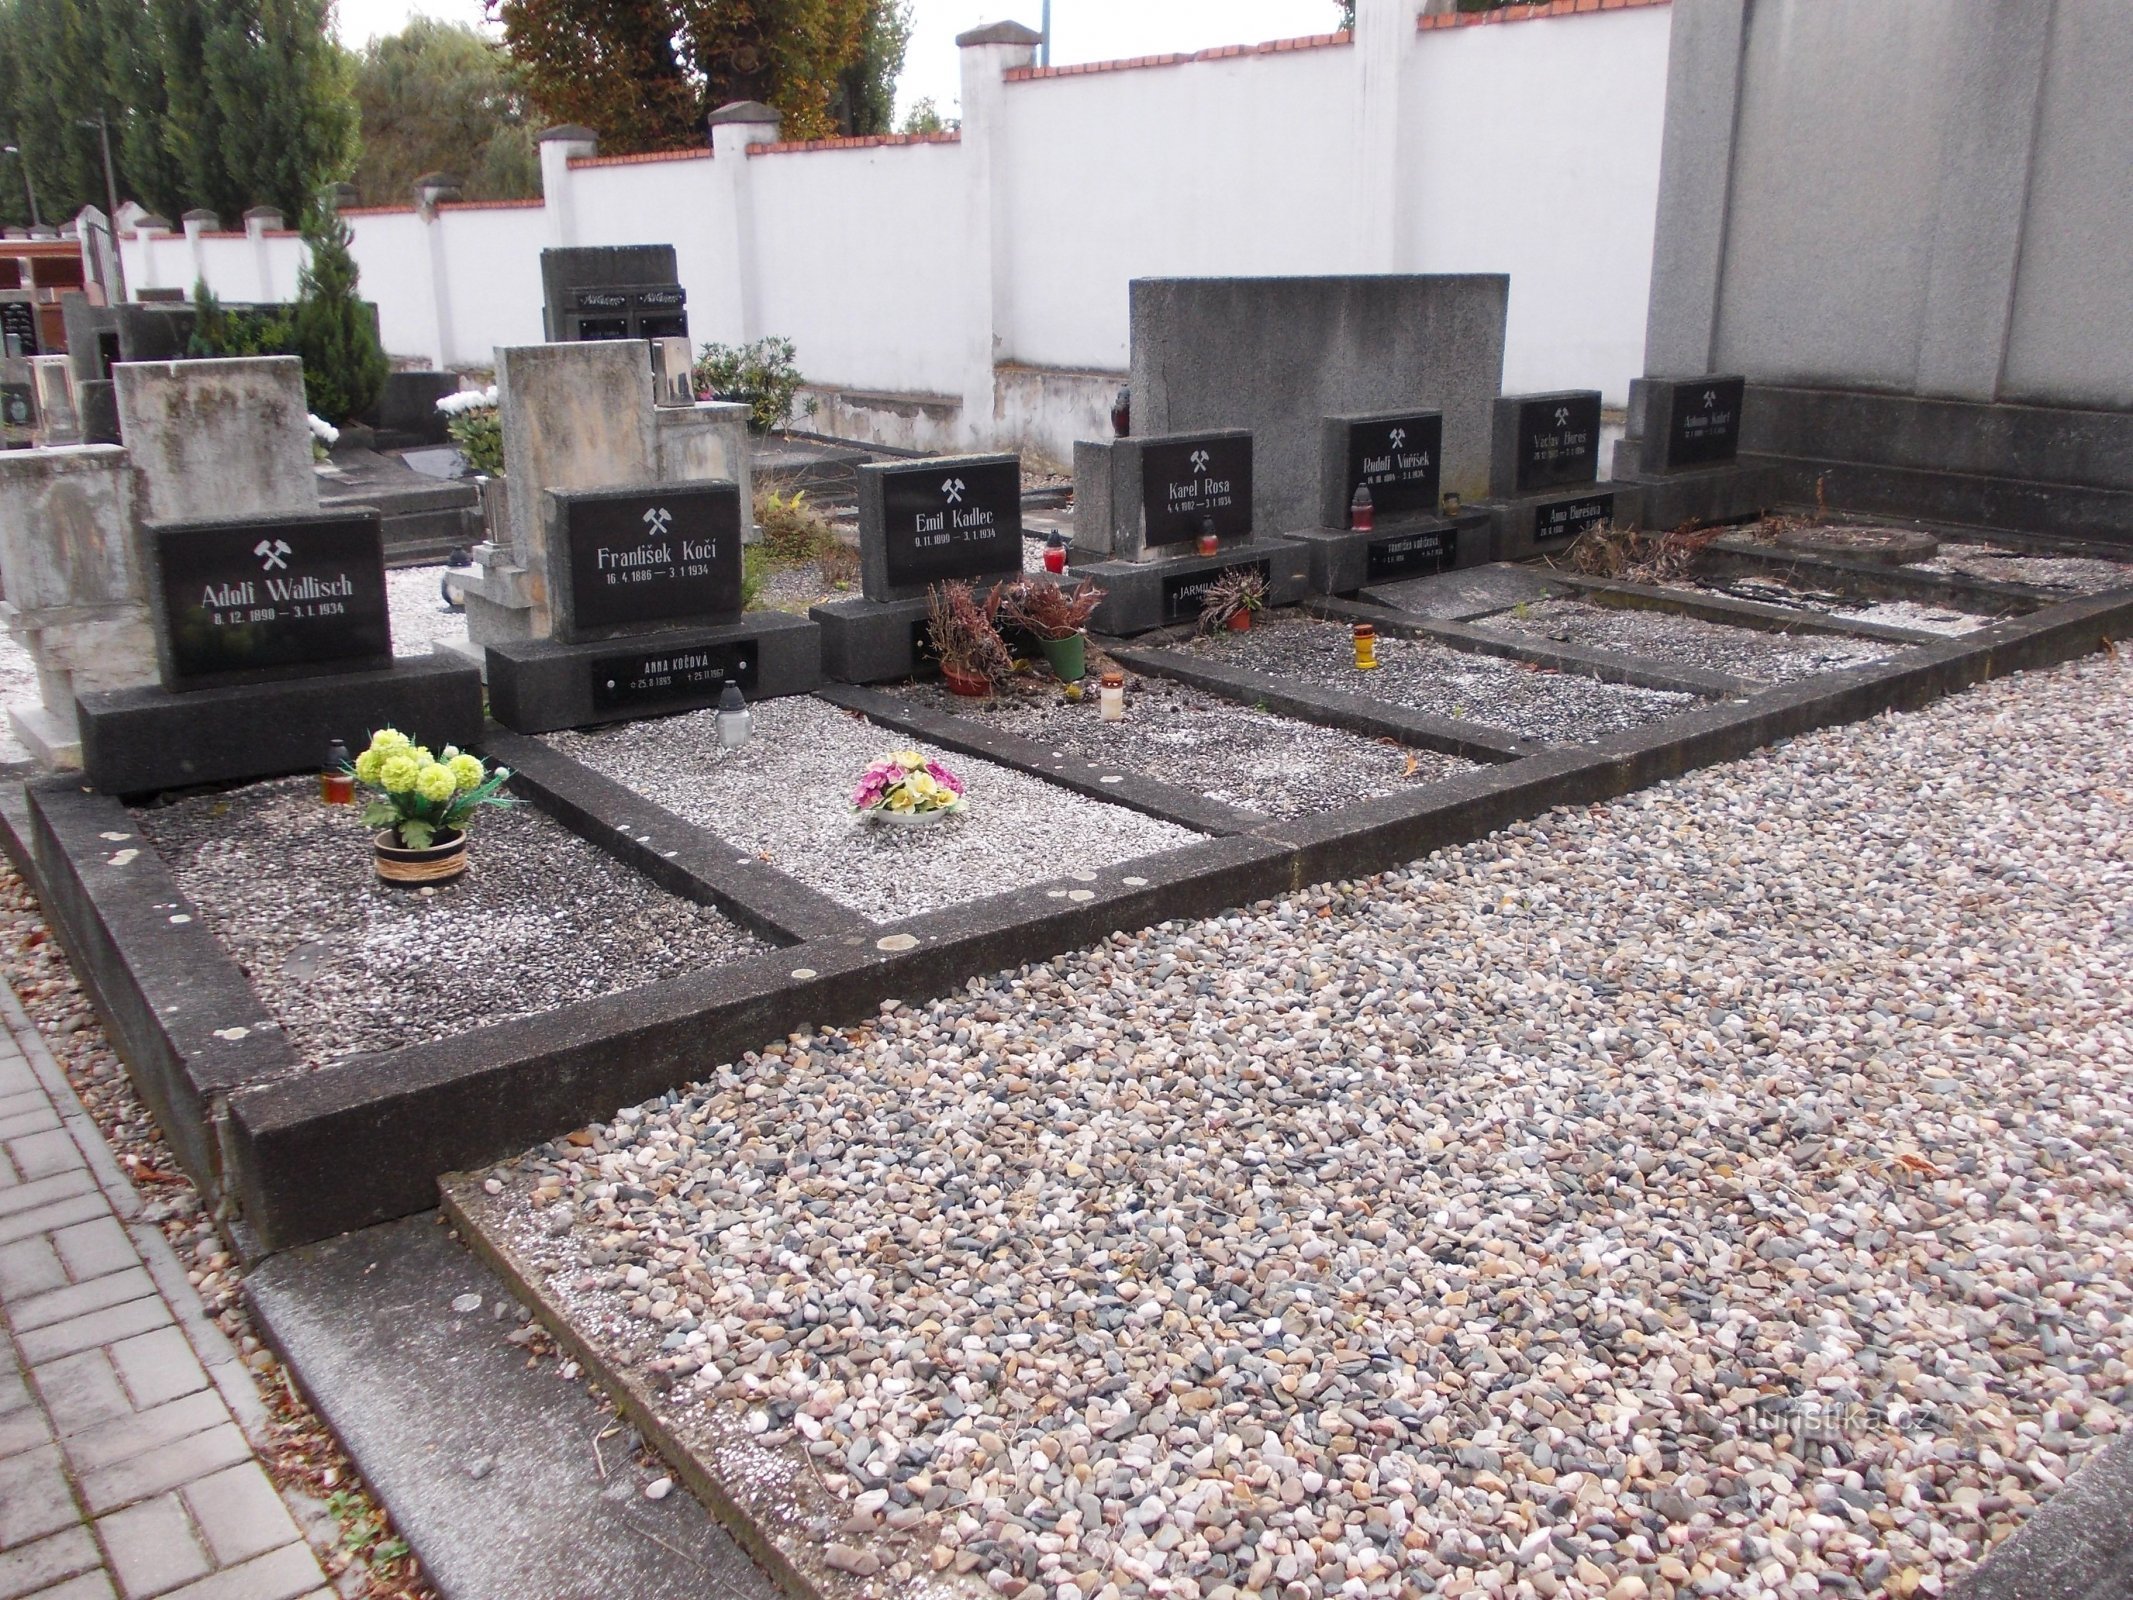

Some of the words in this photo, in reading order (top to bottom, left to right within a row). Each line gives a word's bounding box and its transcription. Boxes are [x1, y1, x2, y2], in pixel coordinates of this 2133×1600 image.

[1169, 480, 1198, 500] Karel
[1204, 478, 1230, 495] Rosa
[915, 511, 944, 533] Emil
[952, 507, 994, 528] Kadlec
[597, 542, 672, 569] František
[682, 537, 717, 561] Kočí
[631, 569, 652, 582] 1886
[688, 564, 709, 576] 1934
[200, 581, 256, 609] Adolf
[265, 573, 354, 602] Wallisch
[319, 602, 344, 616] 1934
[644, 659, 669, 674] ANNA
[672, 651, 709, 671] KOČOVÁ
